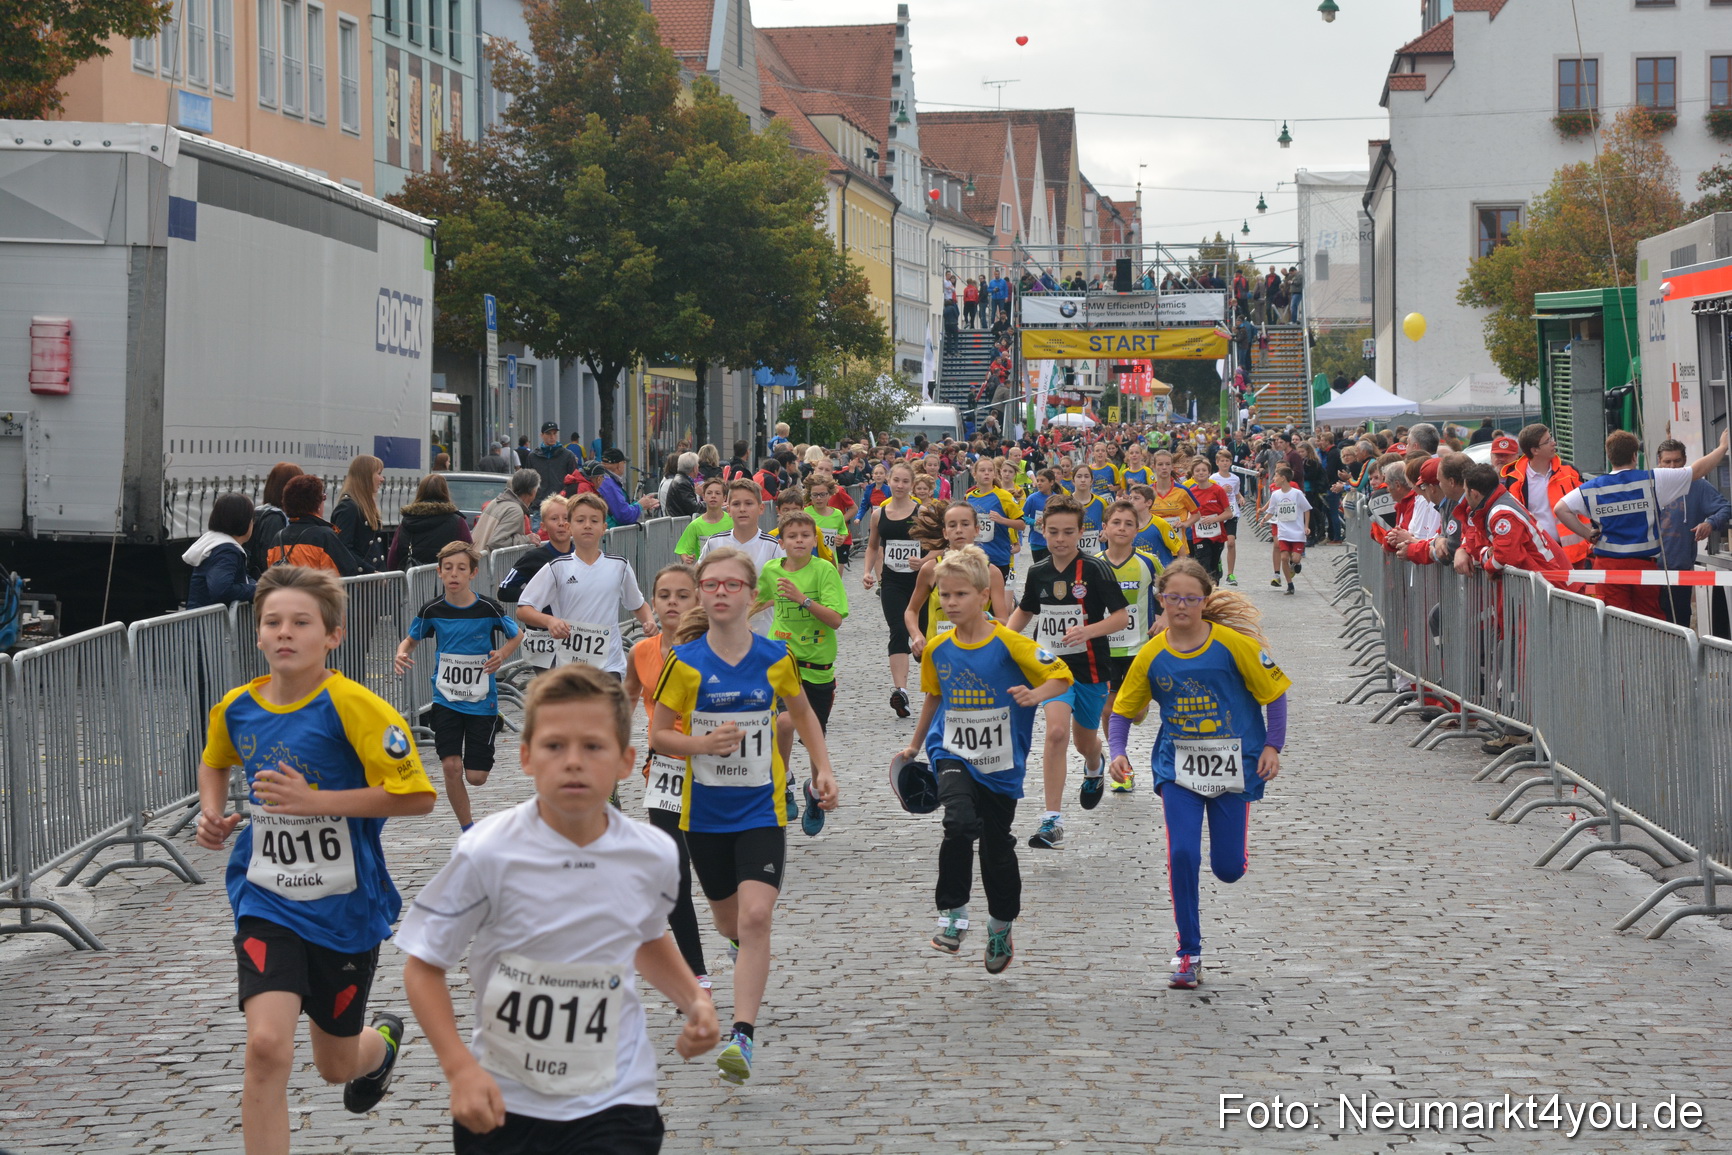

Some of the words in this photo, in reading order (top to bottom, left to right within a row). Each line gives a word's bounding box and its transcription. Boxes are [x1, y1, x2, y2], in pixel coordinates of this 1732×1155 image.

[1081, 302, 1105, 310] BMW
[1107, 301, 1187, 311] EfficientDynamics
[376, 288, 423, 359] BOCK
[1089, 335, 1159, 352] START
[1111, 411, 1117, 419] A
[1279, 506, 1296, 515] 4004
[1595, 501, 1649, 515] SEG-LEITER
[1077, 537, 1097, 549] 027
[888, 548, 917, 560] 4020
[577, 626, 602, 635] Neumarkt
[561, 632, 605, 656] 4012
[1107, 634, 1125, 642] David
[523, 638, 555, 654] 4103
[442, 665, 483, 685] 4007
[449, 688, 473, 697] Yannik
[693, 717, 719, 727] PARTL
[946, 716, 965, 724] PARTL
[966, 715, 999, 724] Neumarkt
[951, 723, 1003, 751] 4041
[652, 760, 676, 771] PARTL
[716, 765, 748, 776] Merle
[1182, 754, 1237, 777] 4024
[655, 772, 685, 798] 40
[1192, 782, 1226, 793] Luciana
[659, 800, 682, 812] Mich
[252, 814, 278, 825] PARTL
[279, 815, 326, 826] Neumarkt
[262, 827, 341, 866] 4016
[276, 873, 324, 888] Patrick
[498, 963, 535, 986] PARTL
[538, 975, 606, 990] Neumarkt
[496, 990, 609, 1044] 4014
[524, 1053, 568, 1076] Luca
